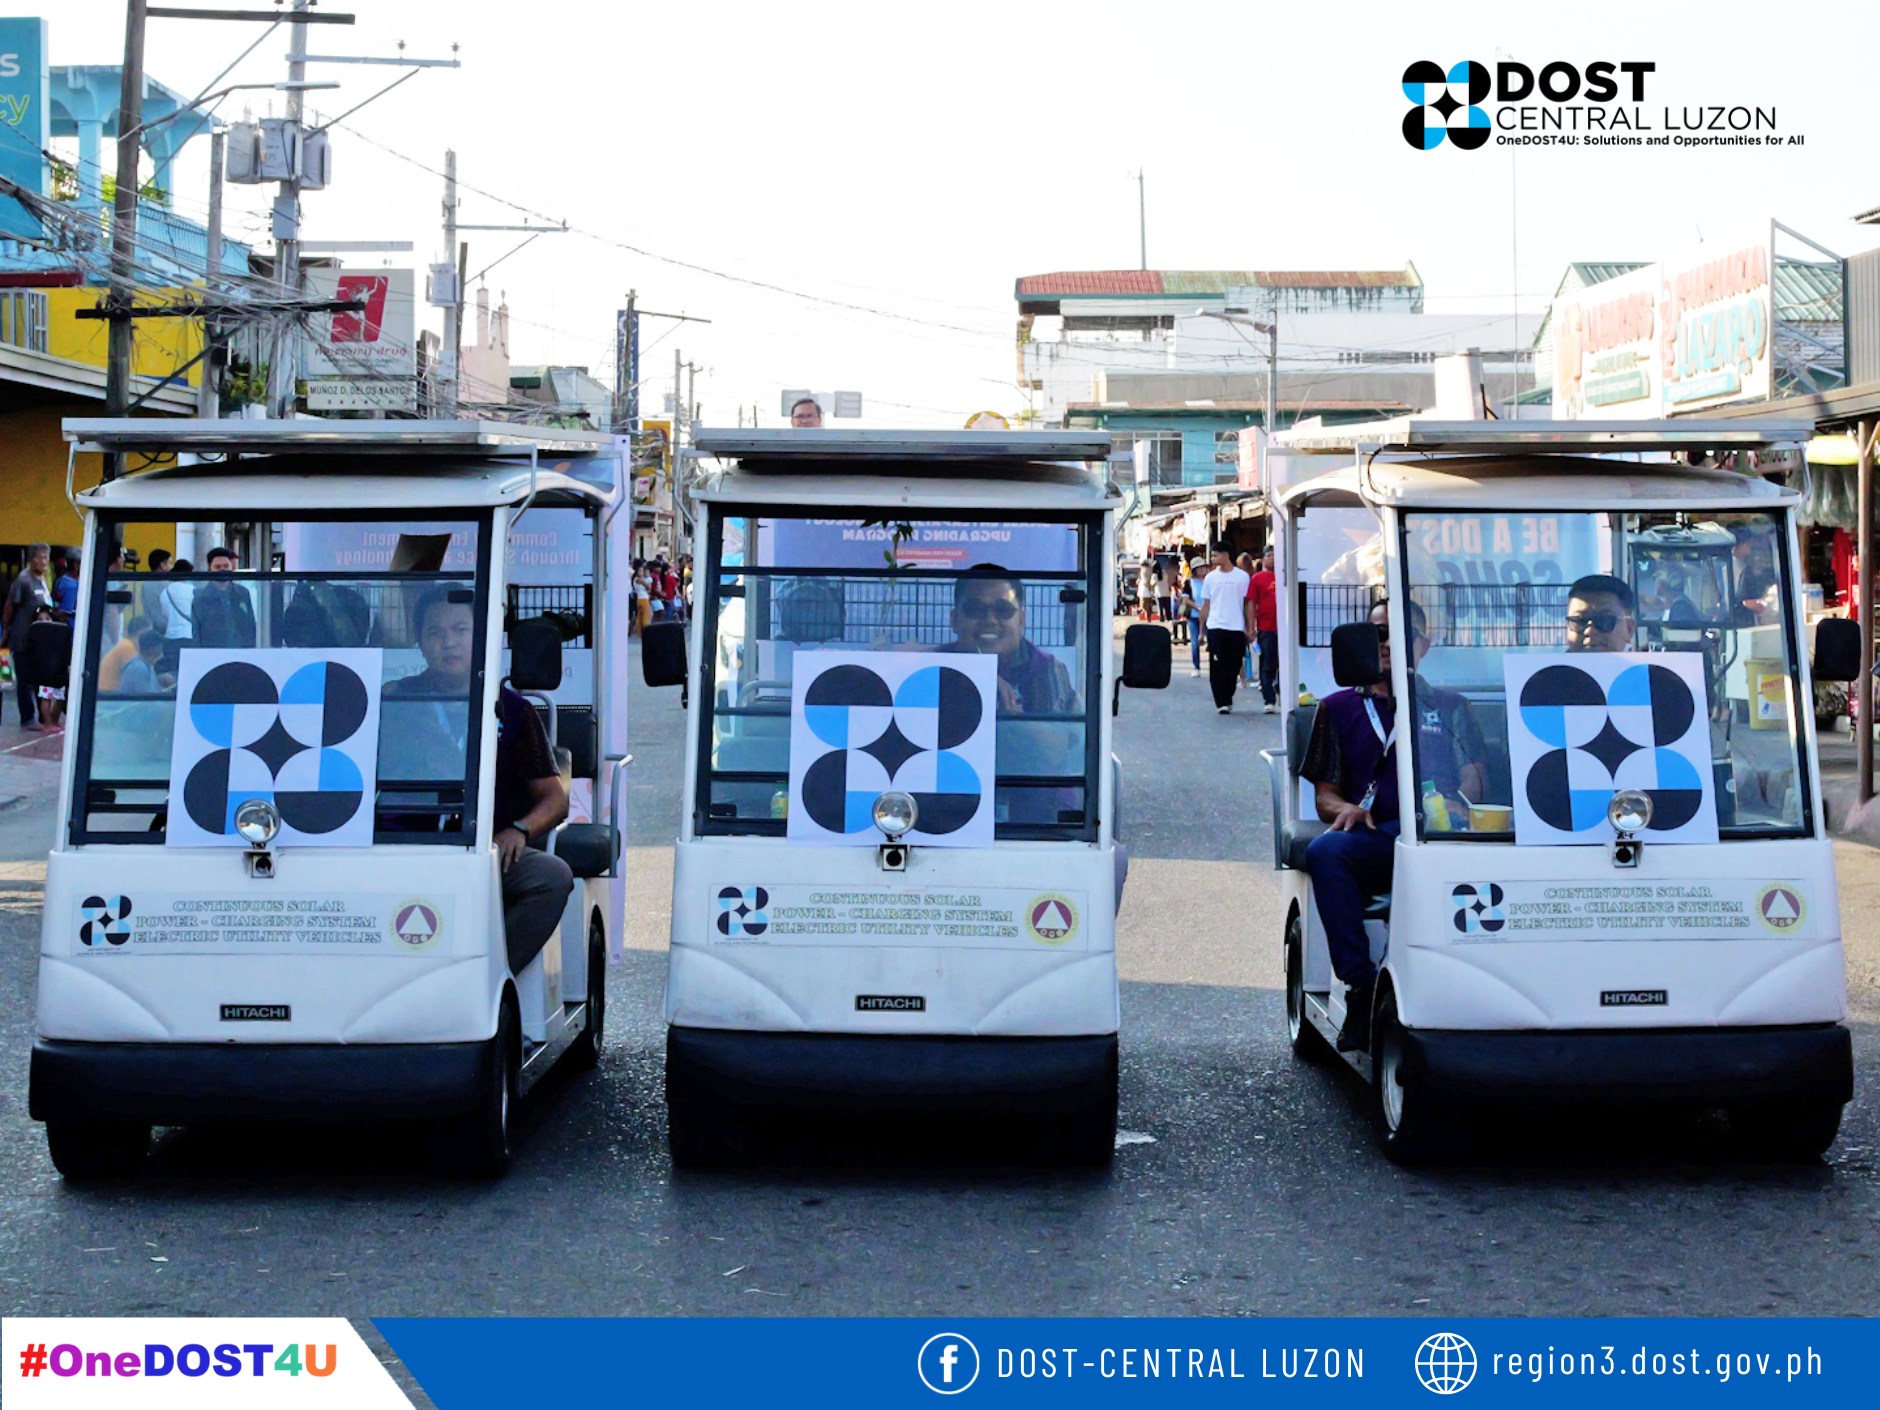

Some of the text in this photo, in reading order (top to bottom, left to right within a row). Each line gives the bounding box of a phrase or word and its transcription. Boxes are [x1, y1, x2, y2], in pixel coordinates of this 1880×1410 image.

[1544, 887, 1711, 899] CONTINUOUS SOLAR
[810, 893, 981, 906] CONTINUOUS SOLAR
[173, 900, 344, 912] CONTINUOUS SOLAR
[1509, 903, 1571, 914] POWER
[1584, 902, 1675, 914] CHARGING
[1678, 902, 1742, 913] SYSTEM
[774, 908, 836, 919] POWER
[849, 908, 942, 921] CHARGING
[945, 910, 1012, 922] SYSTEM
[136, 916, 197, 928] POWER
[211, 915, 305, 927] CHARGING
[307, 916, 376, 927] SYSTEM
[1509, 916, 1750, 930] ELECTRIC UTILITY VEHICLES
[771, 923, 1018, 937] ELECTRIC UTILITY VEHICLES
[134, 931, 381, 943] ELECTRIC UTILITY VEHICLES
[859, 998, 921, 1009] HITACHI
[1604, 993, 1664, 1003] HITACHI
[224, 1007, 286, 1018] HITACHI
